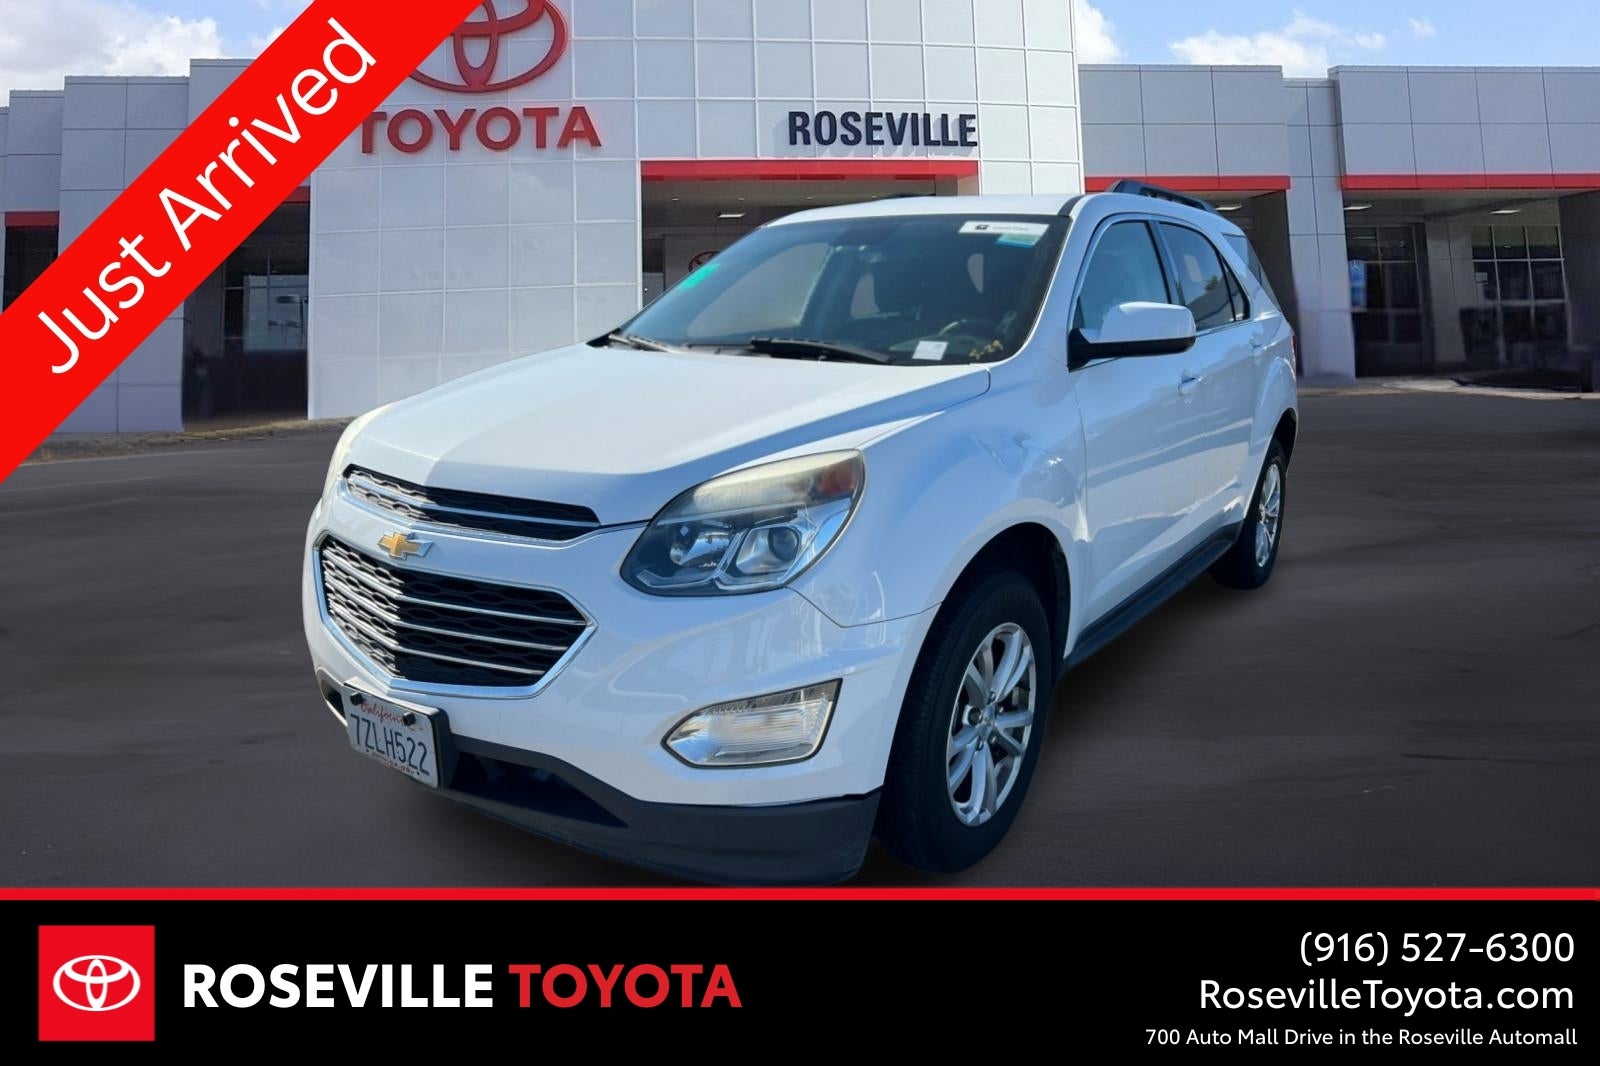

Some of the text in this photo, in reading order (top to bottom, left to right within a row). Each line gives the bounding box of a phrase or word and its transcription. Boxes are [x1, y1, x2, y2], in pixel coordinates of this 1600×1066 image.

[361, 106, 602, 154] TOYOTA
[788, 111, 978, 147] ROSEVILLE
[350, 713, 430, 776] 7ZLH522
